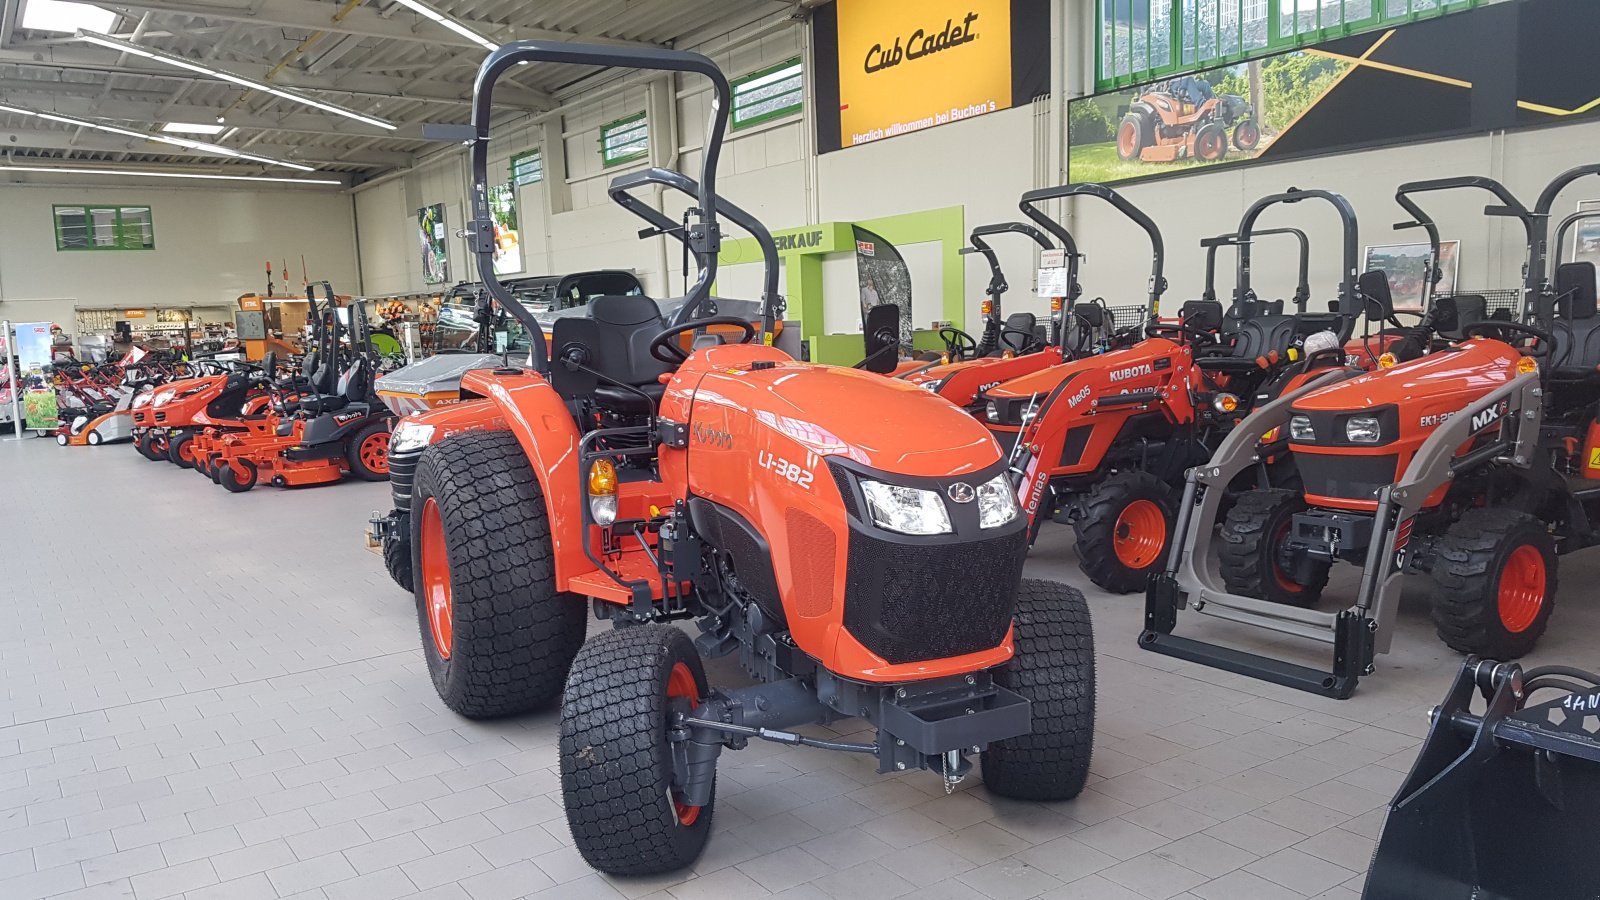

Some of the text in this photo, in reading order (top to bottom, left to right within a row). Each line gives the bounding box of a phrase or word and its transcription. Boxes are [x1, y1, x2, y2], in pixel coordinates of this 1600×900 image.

[864, 11, 979, 74] Cub Cadet
[852, 127, 884, 145] Herzlich
[884, 117, 934, 137] willkommen
[935, 112, 950, 127] bei
[773, 230, 823, 251] ERKAUF
[1109, 364, 1152, 382] KUBOTA
[1067, 384, 1092, 409] Me05
[1472, 403, 1499, 431] MX
[758, 449, 815, 490] L1-382
